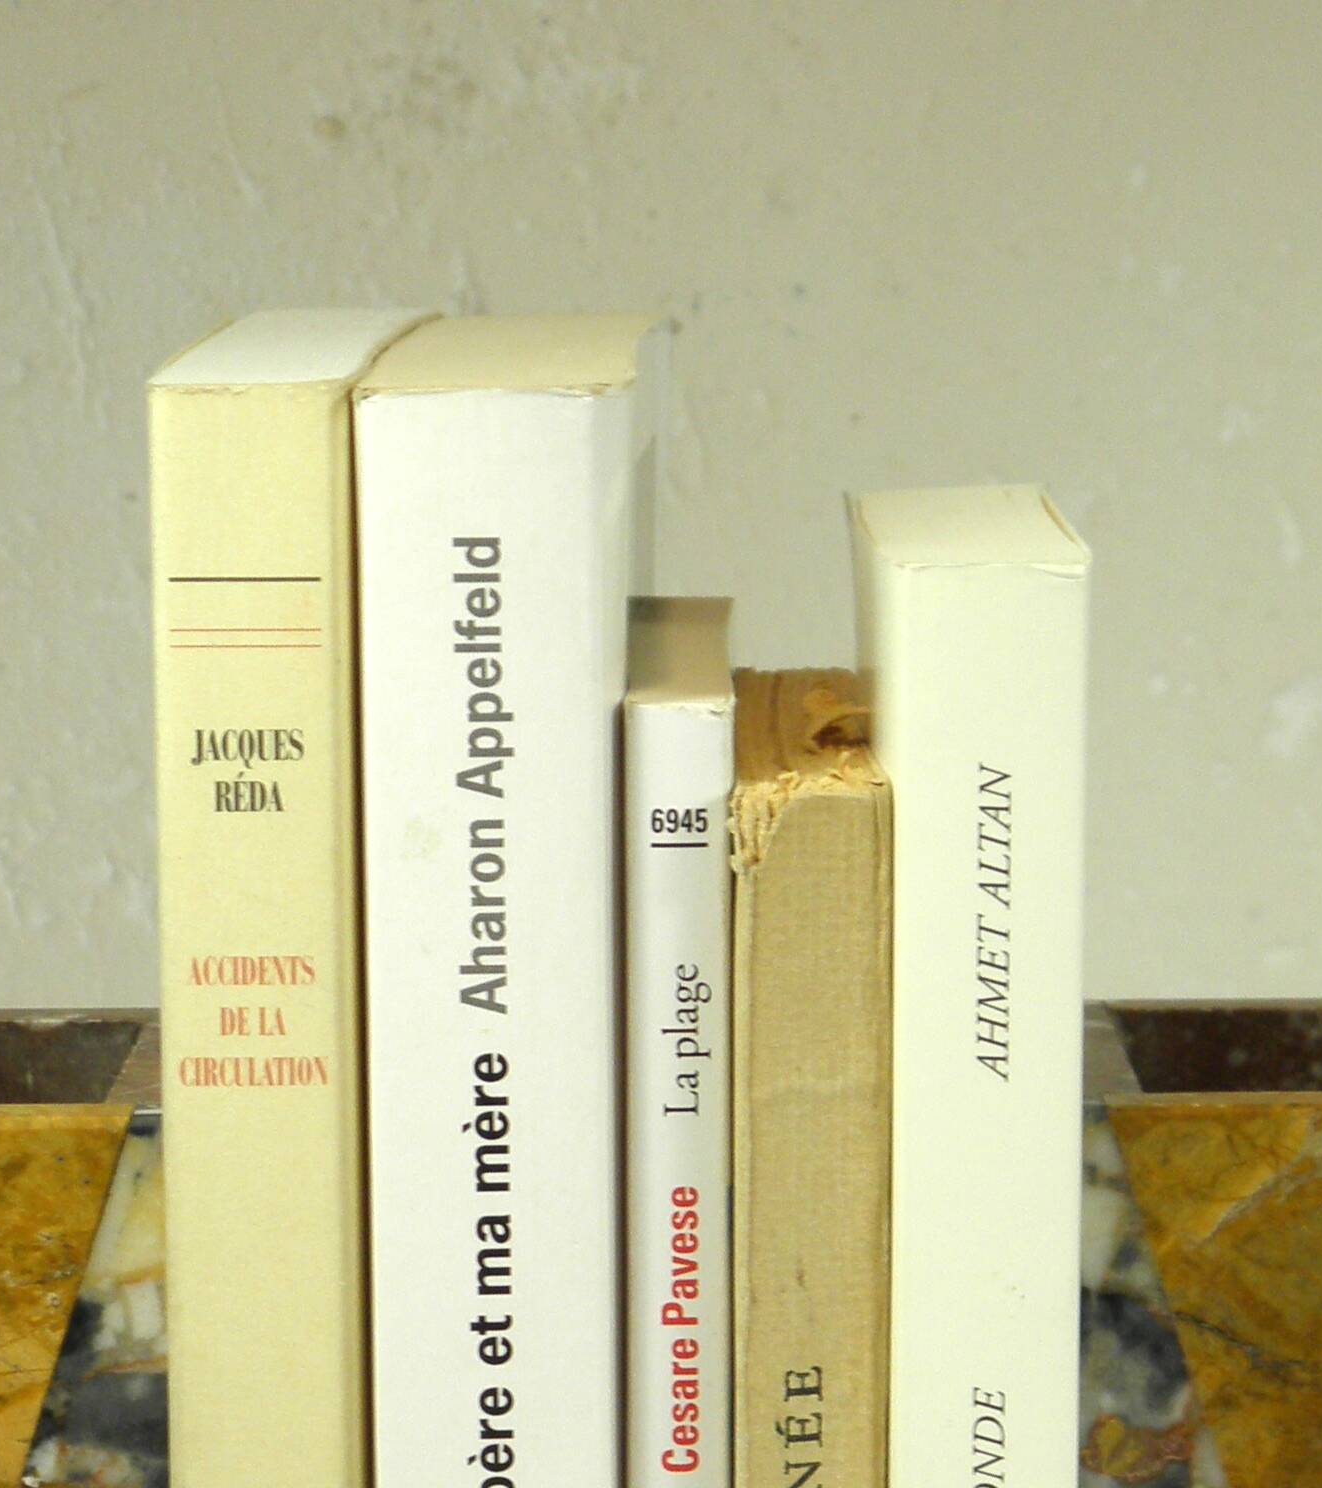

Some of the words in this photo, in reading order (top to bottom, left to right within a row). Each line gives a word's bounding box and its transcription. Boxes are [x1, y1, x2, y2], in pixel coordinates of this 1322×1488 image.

[453, 538, 514, 798] Appelfeld
[192, 730, 304, 768] JACQUES
[216, 781, 283, 812] RÉDA
[652, 809, 709, 833] 6945
[978, 765, 1011, 906] ALTAN
[460, 820, 507, 1014] Aharon
[192, 956, 315, 985] ACCIDENTS
[977, 914, 1009, 1079] AHMET
[221, 1007, 249, 1036] DE
[260, 1007, 285, 1036] LA
[662, 965, 712, 1058] plage
[180, 1057, 327, 1086] CIRCULATION
[665, 1071, 699, 1114] La
[463, 1054, 509, 1192] mère
[477, 1215, 511, 1295] ma
[662, 1187, 699, 1325] Pavese
[471, 1315, 512, 1365] et
[662, 1339, 699, 1472] Cesare
